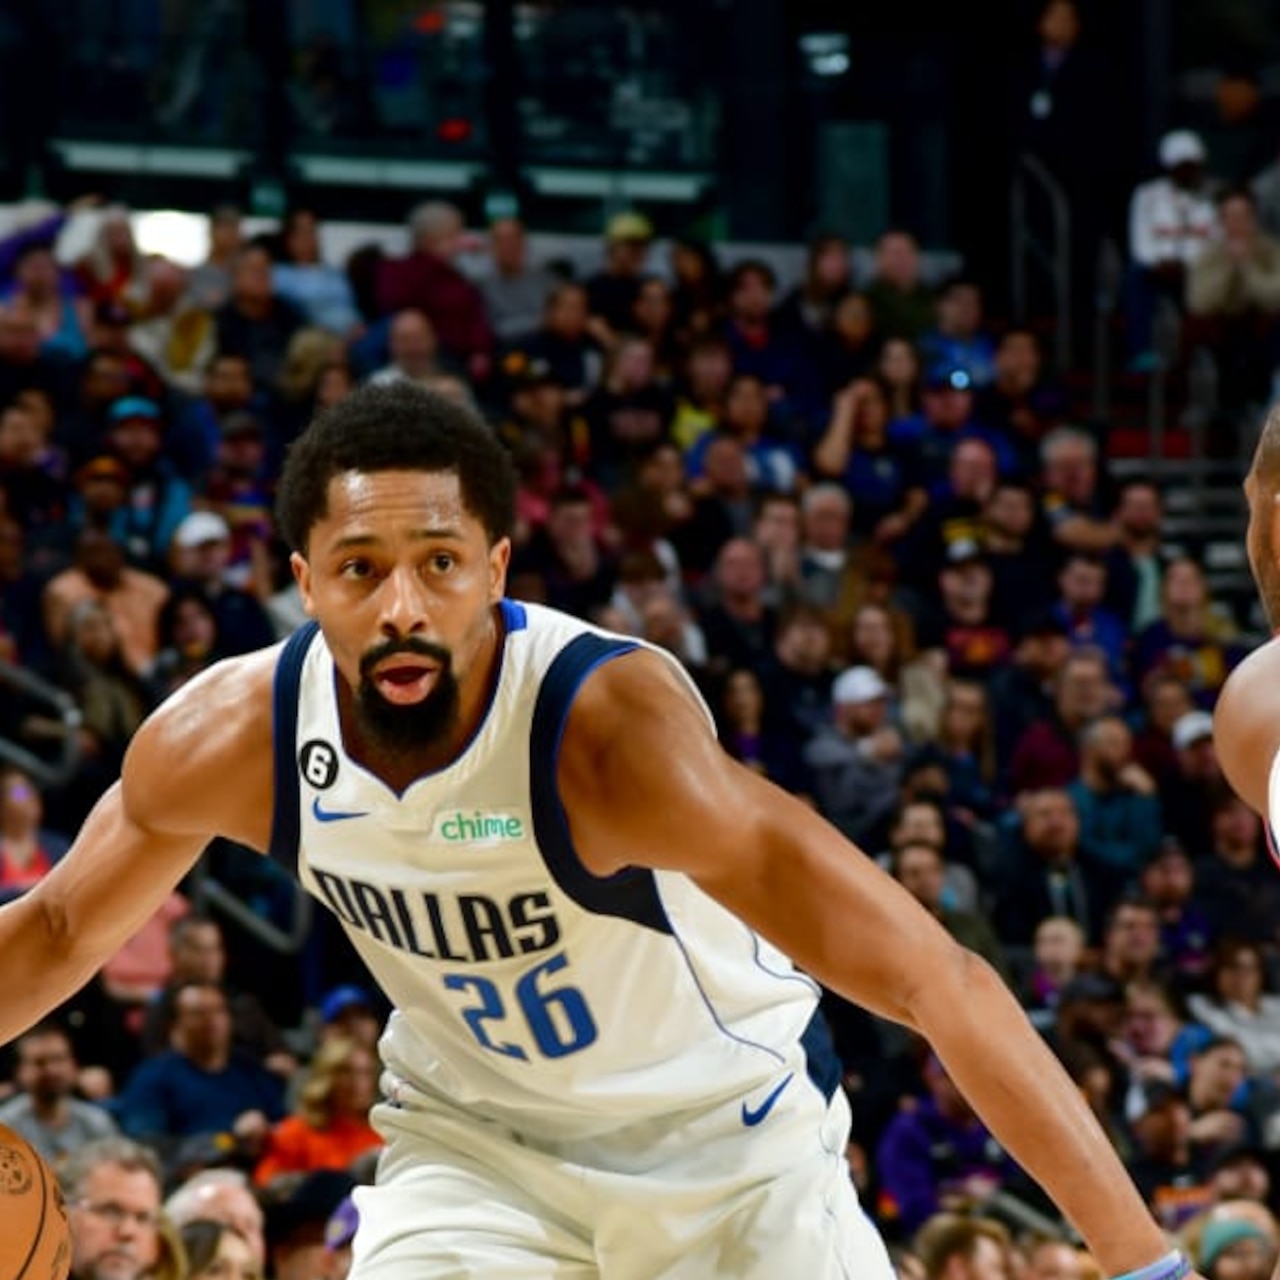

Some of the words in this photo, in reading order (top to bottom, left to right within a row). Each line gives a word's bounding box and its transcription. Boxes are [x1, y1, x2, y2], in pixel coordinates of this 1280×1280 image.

[305, 744, 331, 787] 6
[440, 810, 523, 841] chime
[309, 866, 562, 962] DALLAS
[442, 949, 599, 1064] 26
